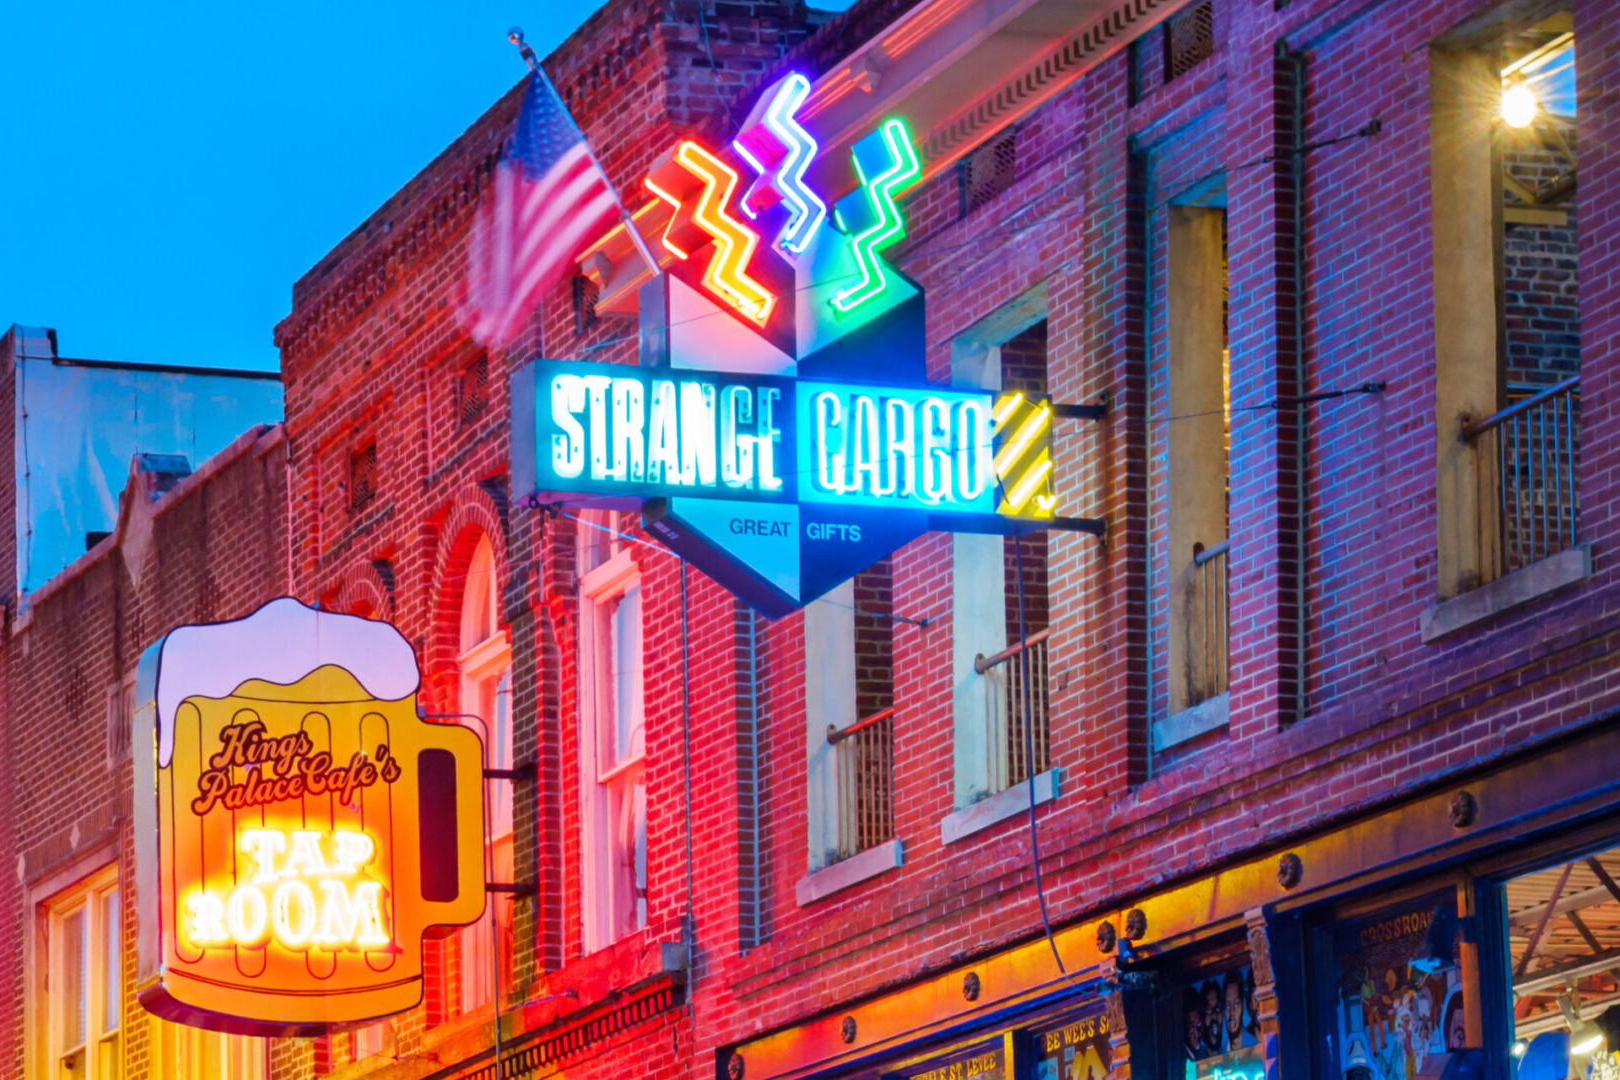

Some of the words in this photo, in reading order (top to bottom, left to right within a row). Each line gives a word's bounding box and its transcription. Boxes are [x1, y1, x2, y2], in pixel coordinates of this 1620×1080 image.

[549, 373, 783, 492] STRANGE
[810, 390, 986, 506] CARGO
[729, 517, 792, 538] GREAT
[806, 521, 862, 542] GIFTS
[191, 768, 303, 816] Palace
[299, 743, 401, 806] Cafe's
[239, 827, 377, 885] TAP
[188, 876, 390, 947] ROOM
[1360, 911, 1431, 948] CROSSROA
[1063, 1018, 1096, 1047] WEE'S
[1098, 1016, 1111, 1037] S
[967, 1051, 997, 1079] LEVEE
